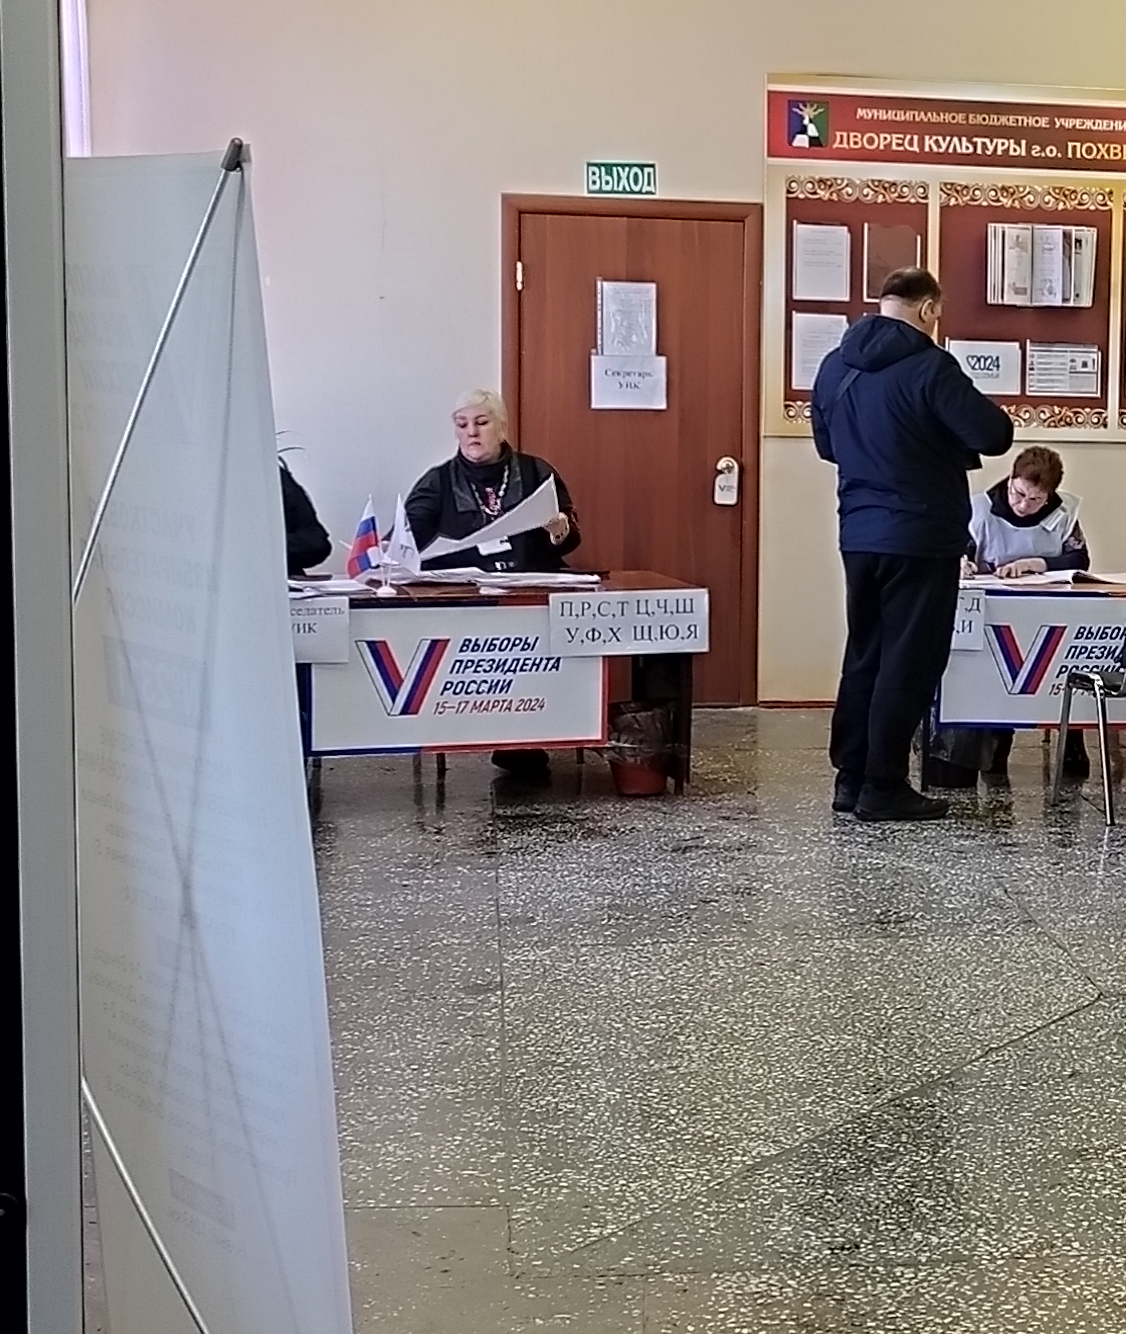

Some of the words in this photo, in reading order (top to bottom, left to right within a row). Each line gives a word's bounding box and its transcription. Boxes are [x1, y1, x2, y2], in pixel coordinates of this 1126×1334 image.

[856, 107, 967, 124] МУНИЦИПАЛЬНОЕ
[968, 113, 1050, 129] БЮДЖЕТНОЕ
[832, 130, 920, 153] ДВОРЕЦ
[924, 135, 1027, 158] КУЛЬТУРЫ
[1031, 144, 1063, 159] г.о.
[588, 166, 656, 194] ВЫХОД
[971, 354, 1001, 372] 2024
[290, 607, 345, 617] седатель
[458, 636, 540, 654] ВЫБОРЫ
[449, 656, 562, 676] ПРЕЗИДЕНТА
[439, 679, 513, 696] РОССИИ
[470, 699, 513, 714] МАРТА
[514, 698, 546, 713] 2024
